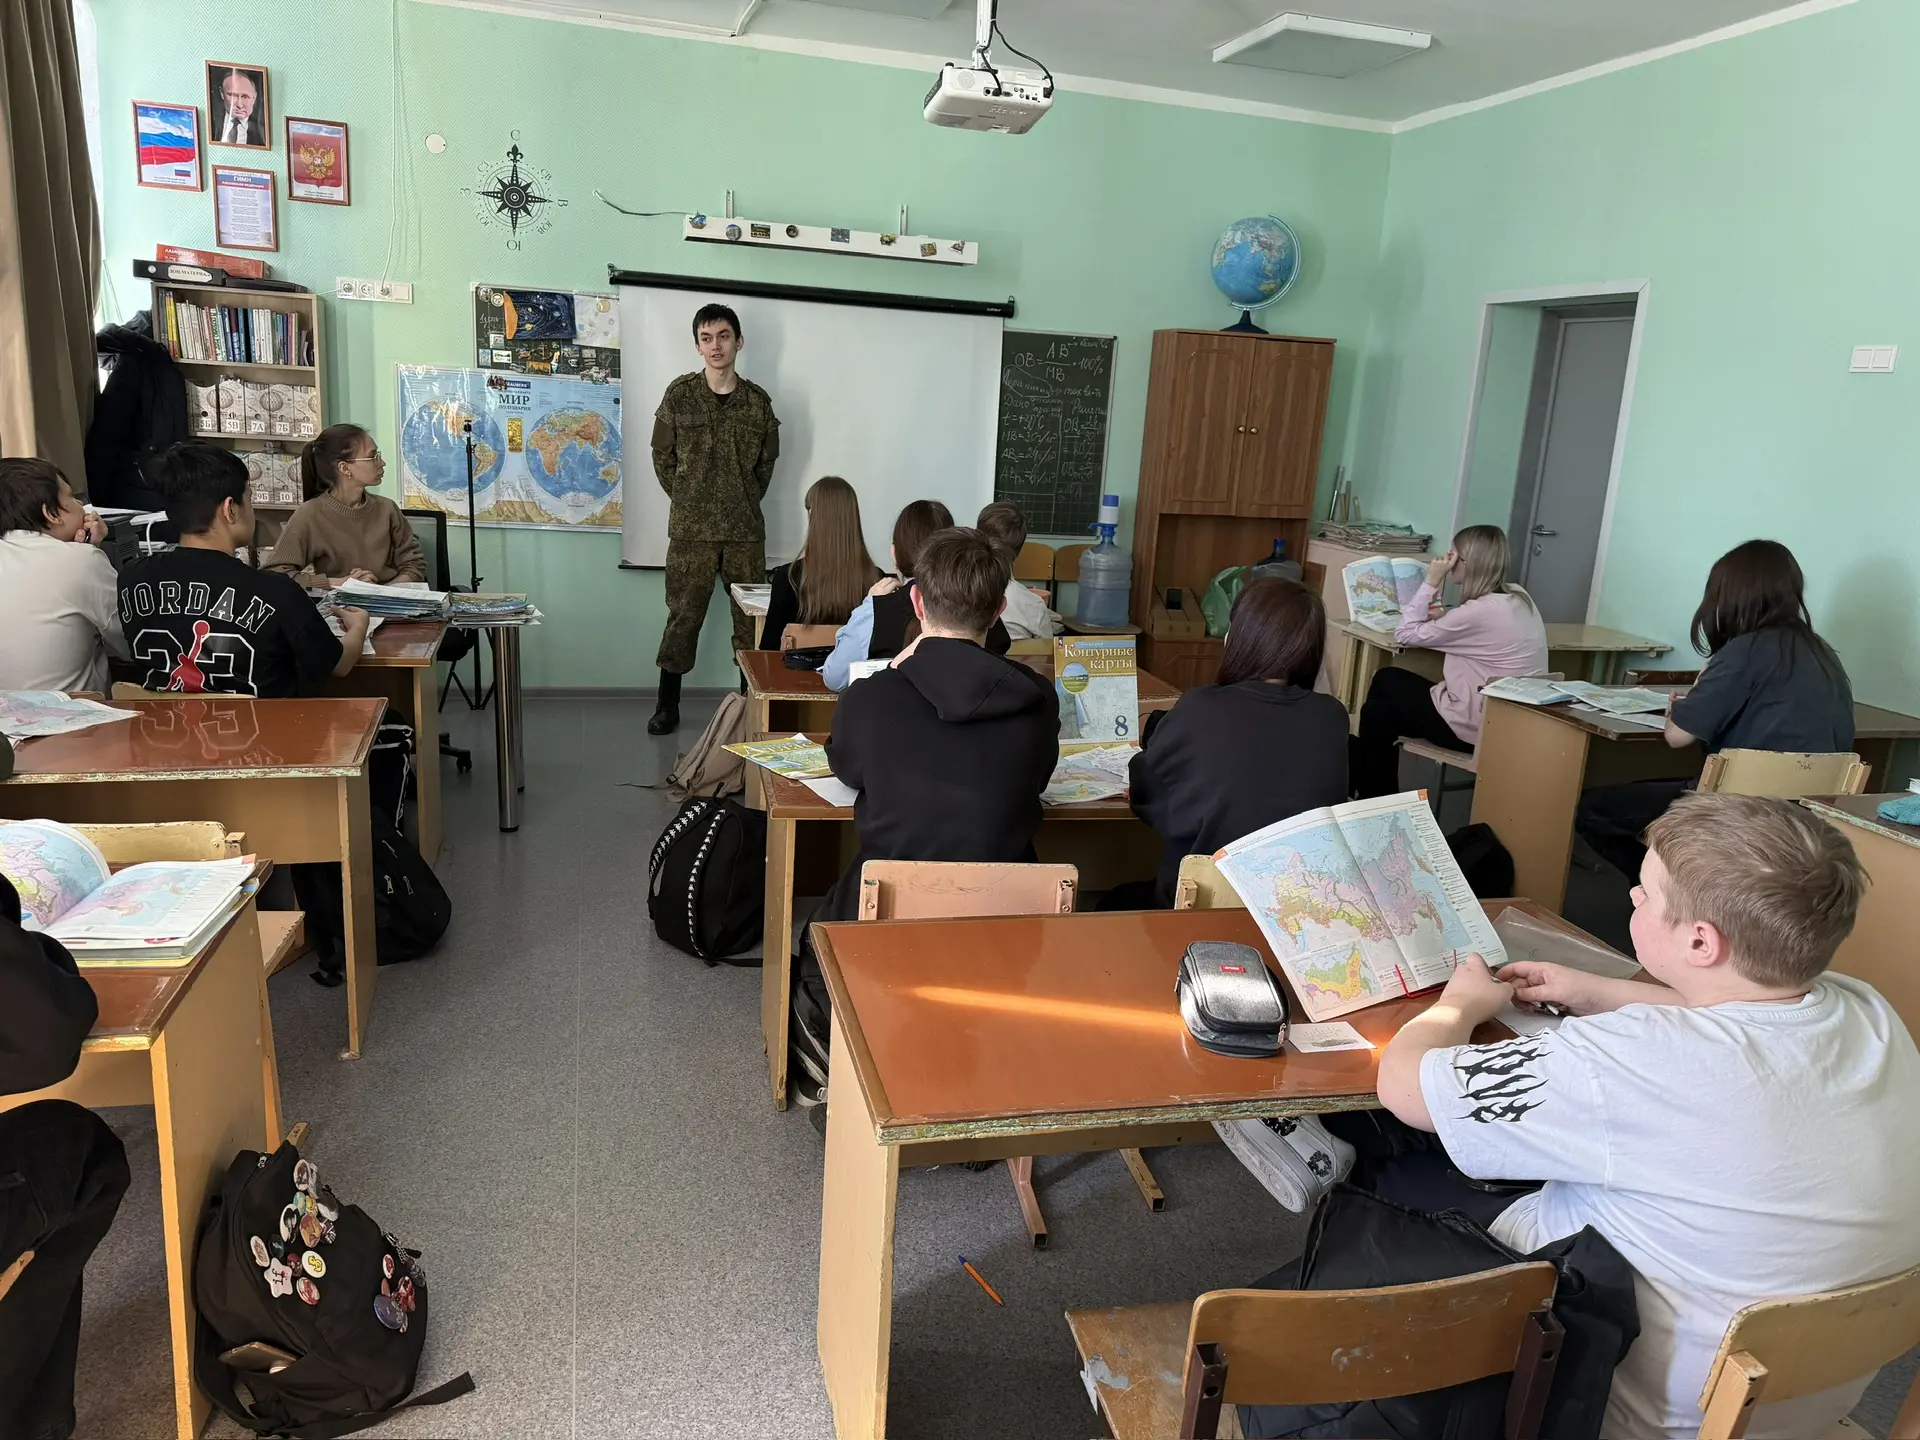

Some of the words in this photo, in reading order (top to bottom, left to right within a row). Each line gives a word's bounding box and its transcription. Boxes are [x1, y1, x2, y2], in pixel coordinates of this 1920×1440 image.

[499, 394, 530, 405] МИР
[227, 421, 239, 430] 5В
[252, 423, 264, 431] 7А
[277, 423, 289, 432] 7Б
[302, 424, 313, 433] 7В
[257, 492, 268, 500] 9Б
[121, 580, 276, 634] JORDAN
[1064, 644, 1133, 660] Контурные
[133, 628, 258, 699] 23
[1090, 659, 1133, 672] карты
[1114, 715, 1129, 737] 8
